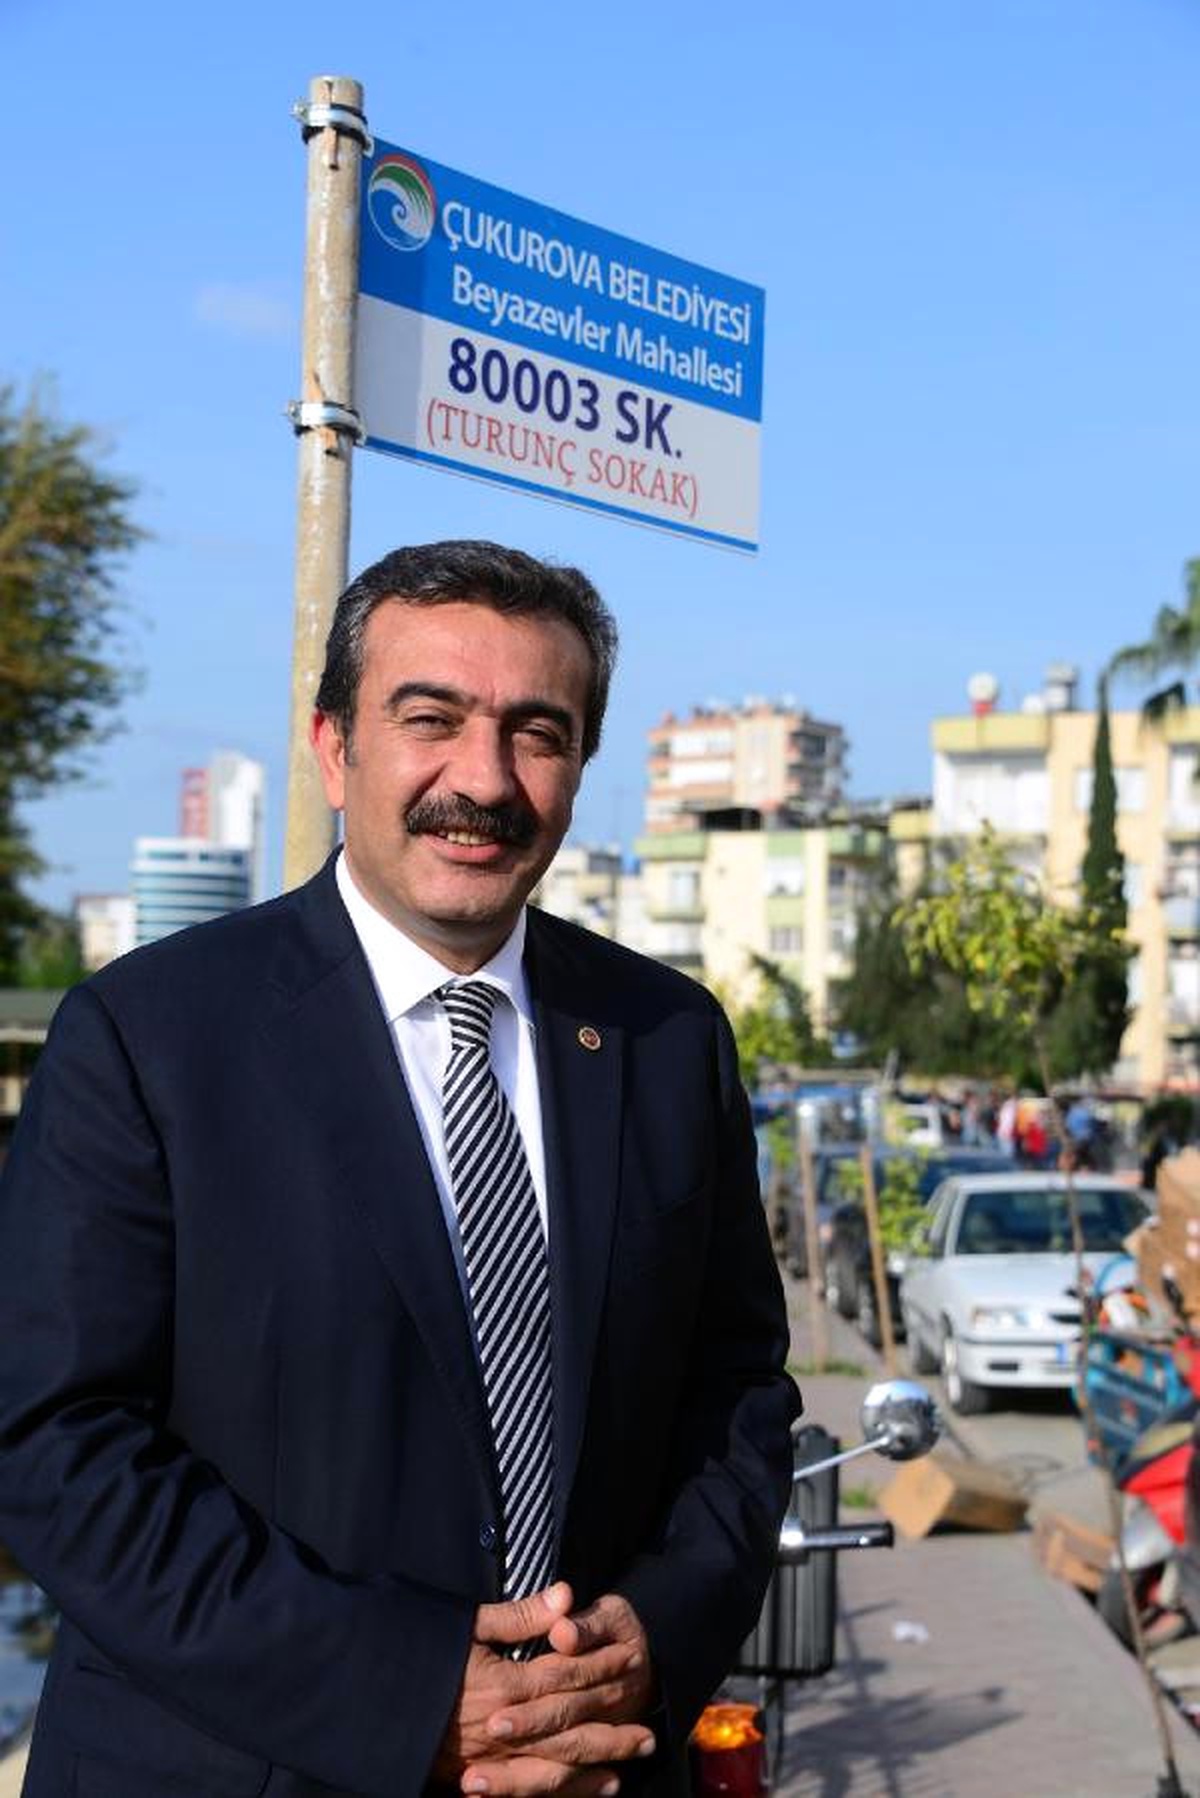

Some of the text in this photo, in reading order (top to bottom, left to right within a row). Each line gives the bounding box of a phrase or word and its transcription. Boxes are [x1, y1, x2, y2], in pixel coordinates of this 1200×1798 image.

[442, 201, 751, 344] ÇUKUROVA BELEDİYESİ
[453, 265, 743, 397] Beyazevler Mahallesi
[427, 398, 698, 517] (TURUNÇ SOKAK)
[448, 337, 682, 458] 80003 SK.
